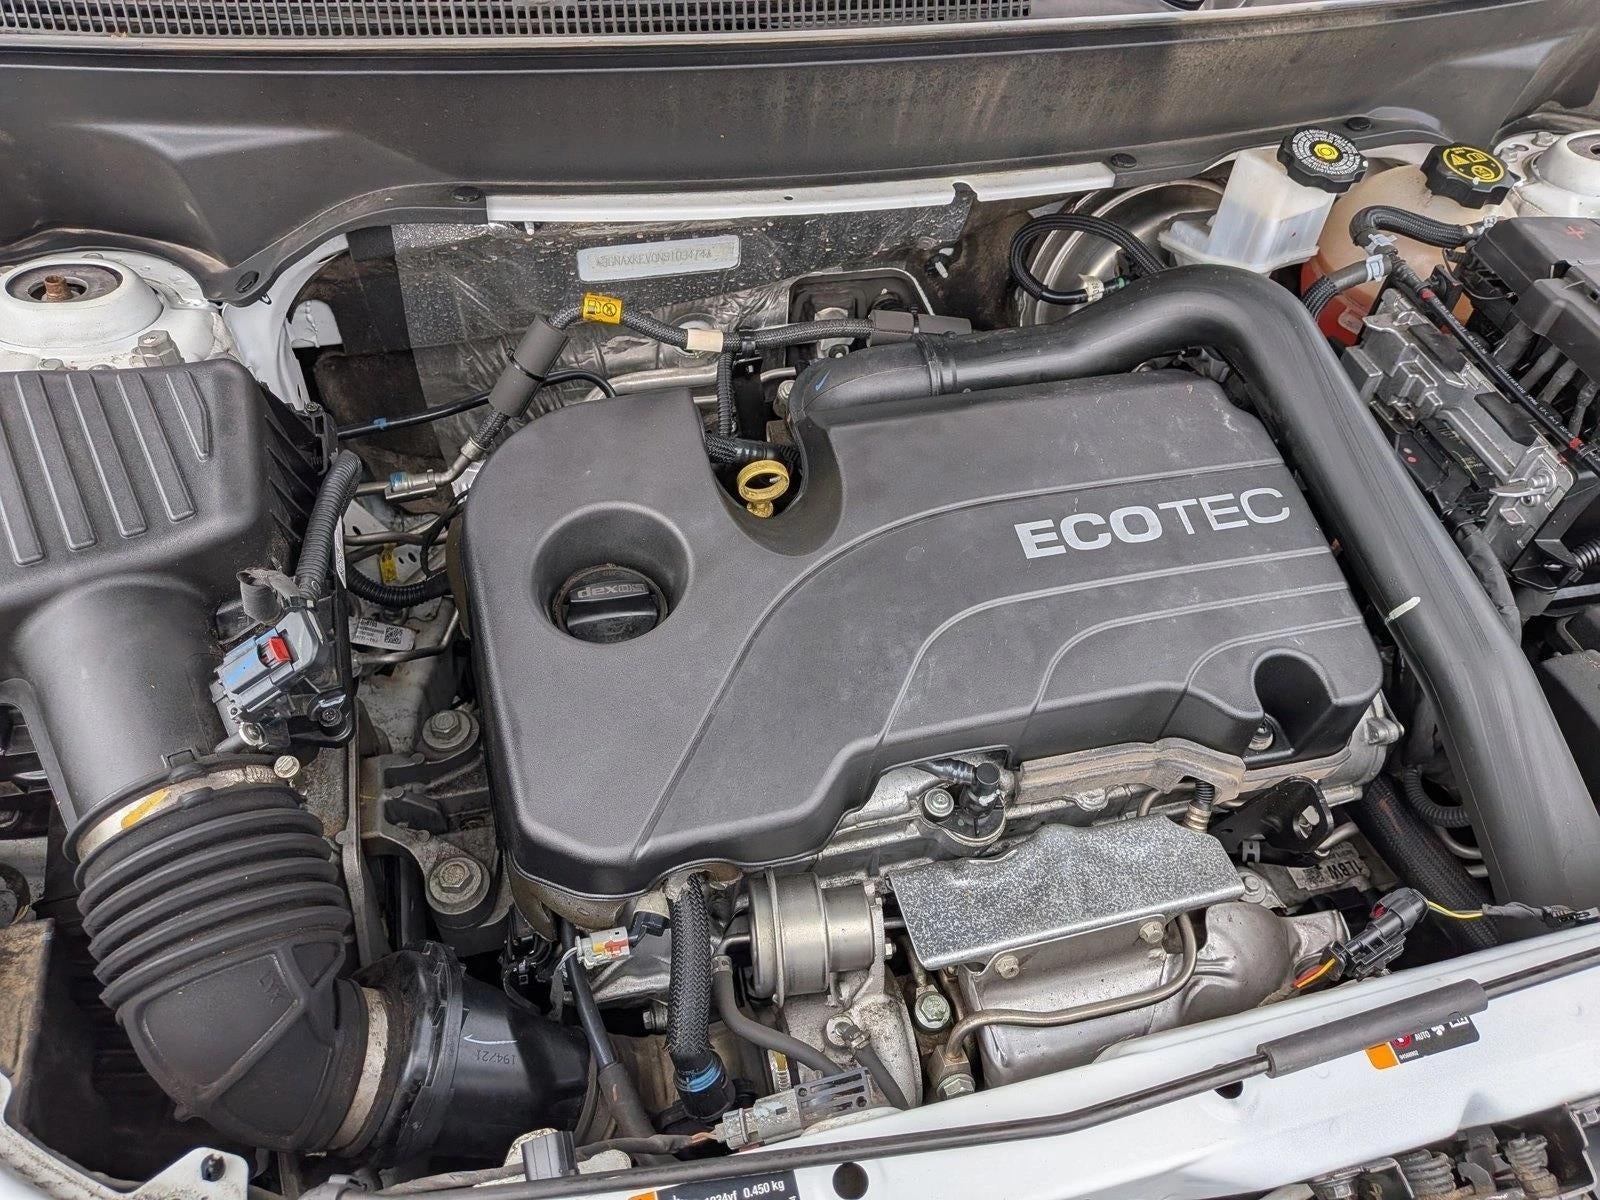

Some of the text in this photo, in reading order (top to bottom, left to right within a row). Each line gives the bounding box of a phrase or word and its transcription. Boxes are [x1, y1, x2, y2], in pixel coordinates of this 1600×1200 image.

[1014, 487, 1290, 559] ECOTEC
[1415, 1030, 1431, 1041] AUTO
[743, 1182, 770, 1198] 0.450
[771, 1180, 785, 1191] kg
